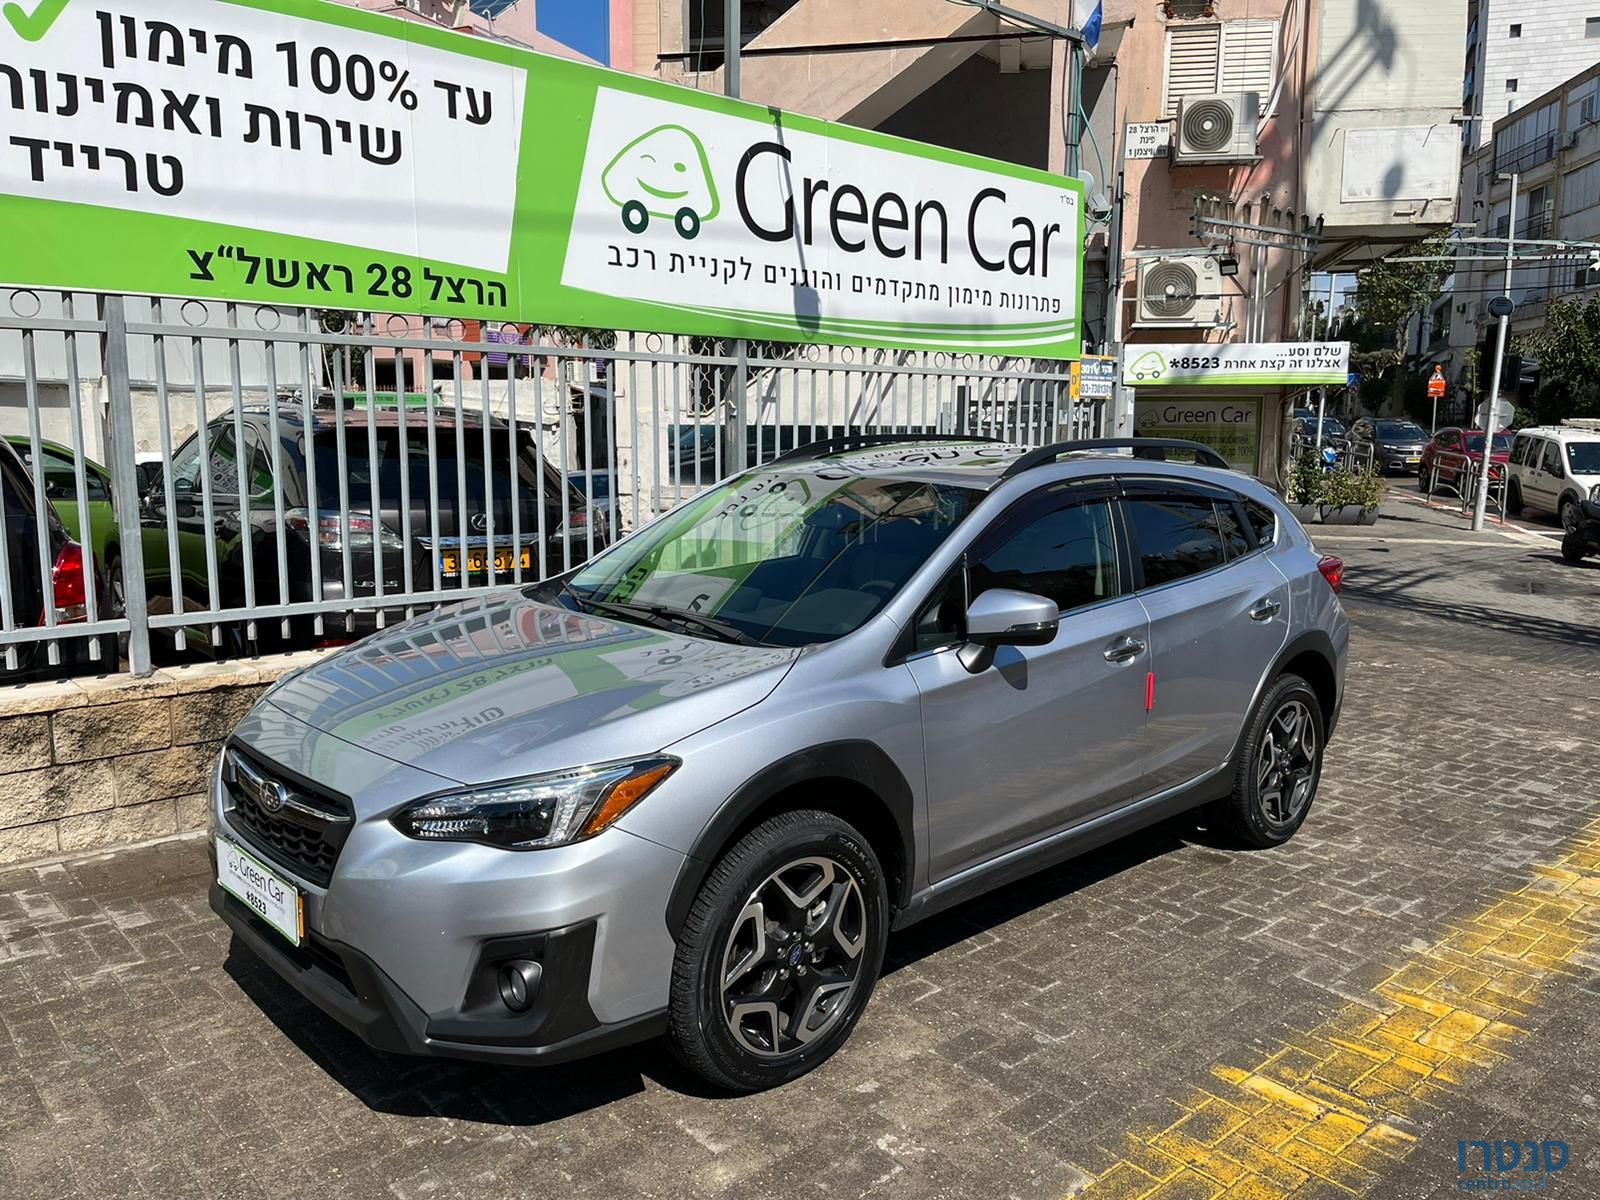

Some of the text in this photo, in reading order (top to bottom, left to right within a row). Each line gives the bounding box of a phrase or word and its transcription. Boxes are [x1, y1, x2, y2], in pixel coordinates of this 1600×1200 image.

[96, 10, 493, 126] עד 100% מימון
[244, 102, 401, 166] שירות
[1128, 126, 1138, 134] 28
[1140, 124, 1159, 133] הרצל
[1139, 135, 1156, 144] פינת
[9, 135, 184, 196] טרייד
[735, 142, 1061, 279] Green Car
[366, 262, 413, 299] 28
[423, 267, 508, 308] הרצל
[607, 244, 1062, 315] פתרונות מימון מתקדמים והוגנים לקניית רכב
[1314, 346, 1342, 357] שלם
[1224, 359, 1257, 369] אחרת
[1259, 359, 1285, 370] קצת
[1288, 359, 1302, 368] זה
[1305, 357, 1341, 368] אצלנו
[1163, 406, 1252, 423] Green Car
[240, 857, 266, 892] Green
[268, 878, 285, 905] Car
